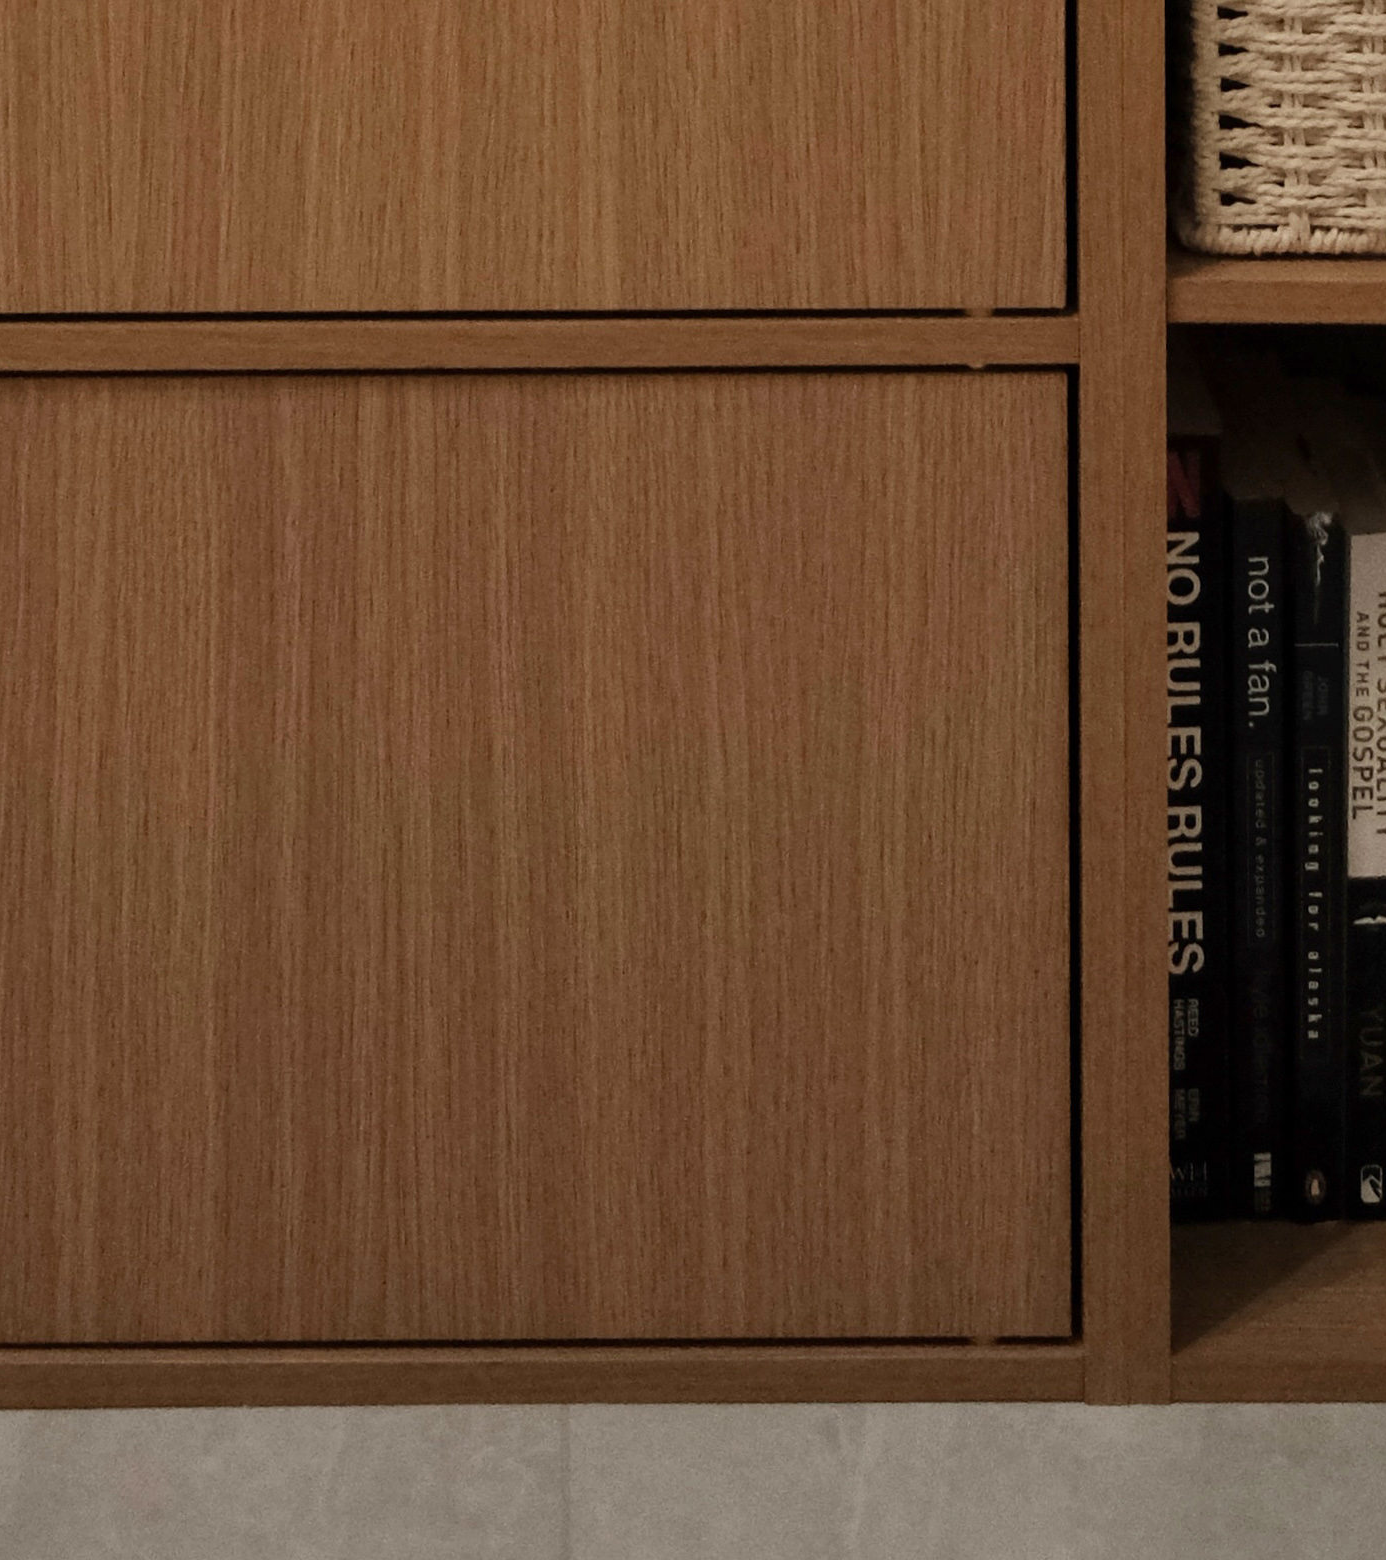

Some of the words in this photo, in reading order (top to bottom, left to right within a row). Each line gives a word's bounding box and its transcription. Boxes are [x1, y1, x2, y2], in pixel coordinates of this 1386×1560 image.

[1167, 531, 1202, 606] NO
[1247, 556, 1275, 614] not
[1247, 628, 1270, 649] a
[1356, 612, 1370, 651] AND
[1167, 622, 1203, 791] RULES
[1247, 658, 1278, 729] fan.
[1356, 660, 1370, 696] THE
[1352, 703, 1373, 819] GOSPEL
[1304, 767, 1324, 873] looking
[1167, 805, 1205, 975] RULES
[1308, 891, 1324, 933] for
[1308, 950, 1323, 1039] alaska
